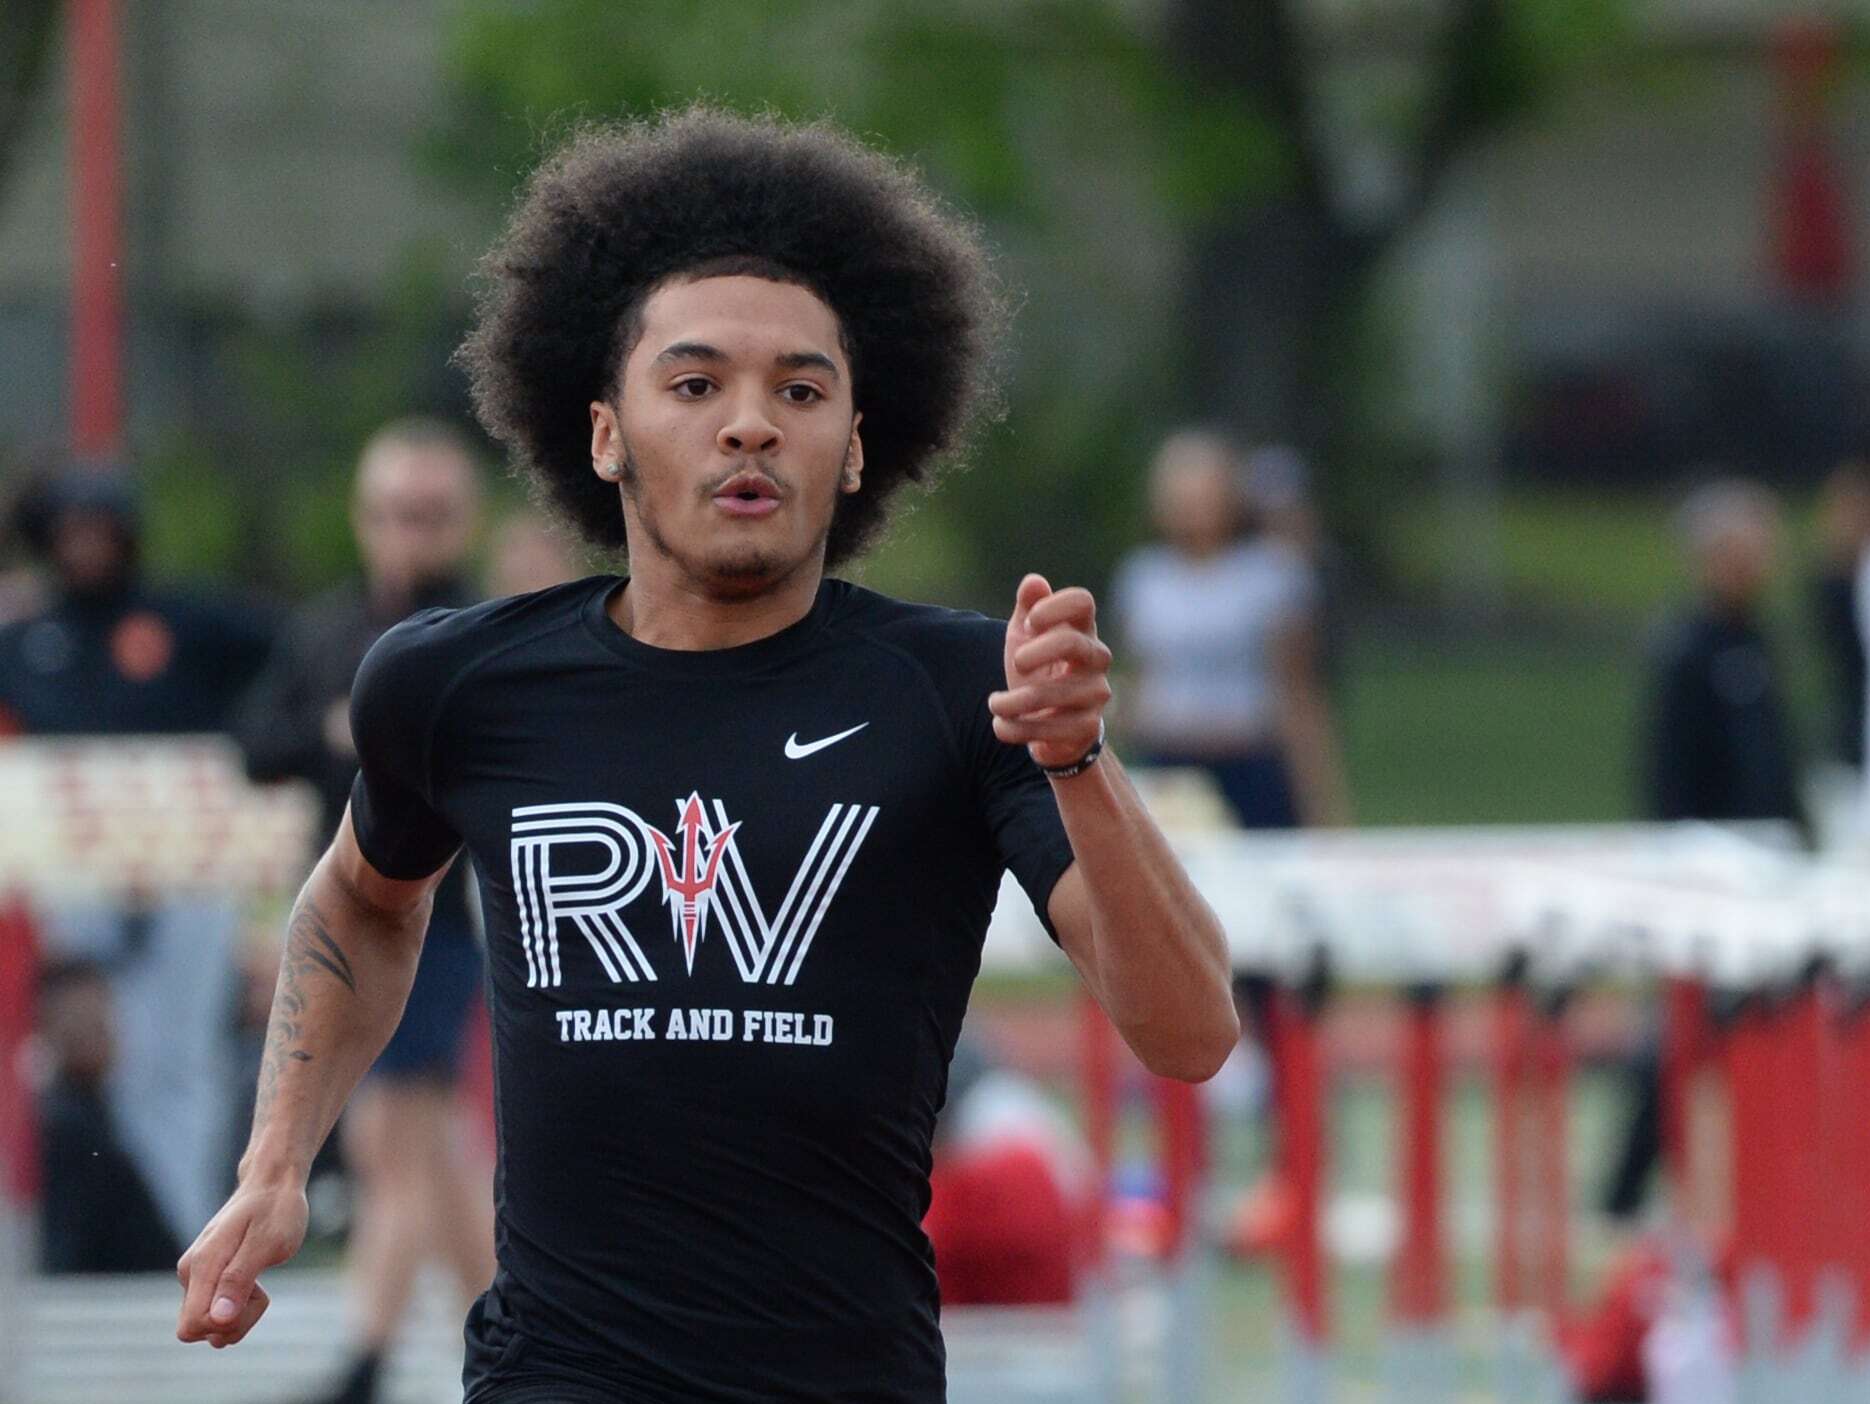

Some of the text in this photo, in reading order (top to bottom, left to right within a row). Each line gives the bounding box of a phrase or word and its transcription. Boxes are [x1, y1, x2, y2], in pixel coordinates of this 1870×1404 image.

[510, 798, 881, 988] RV
[555, 1008, 834, 1046] TRACK AND FIELD
